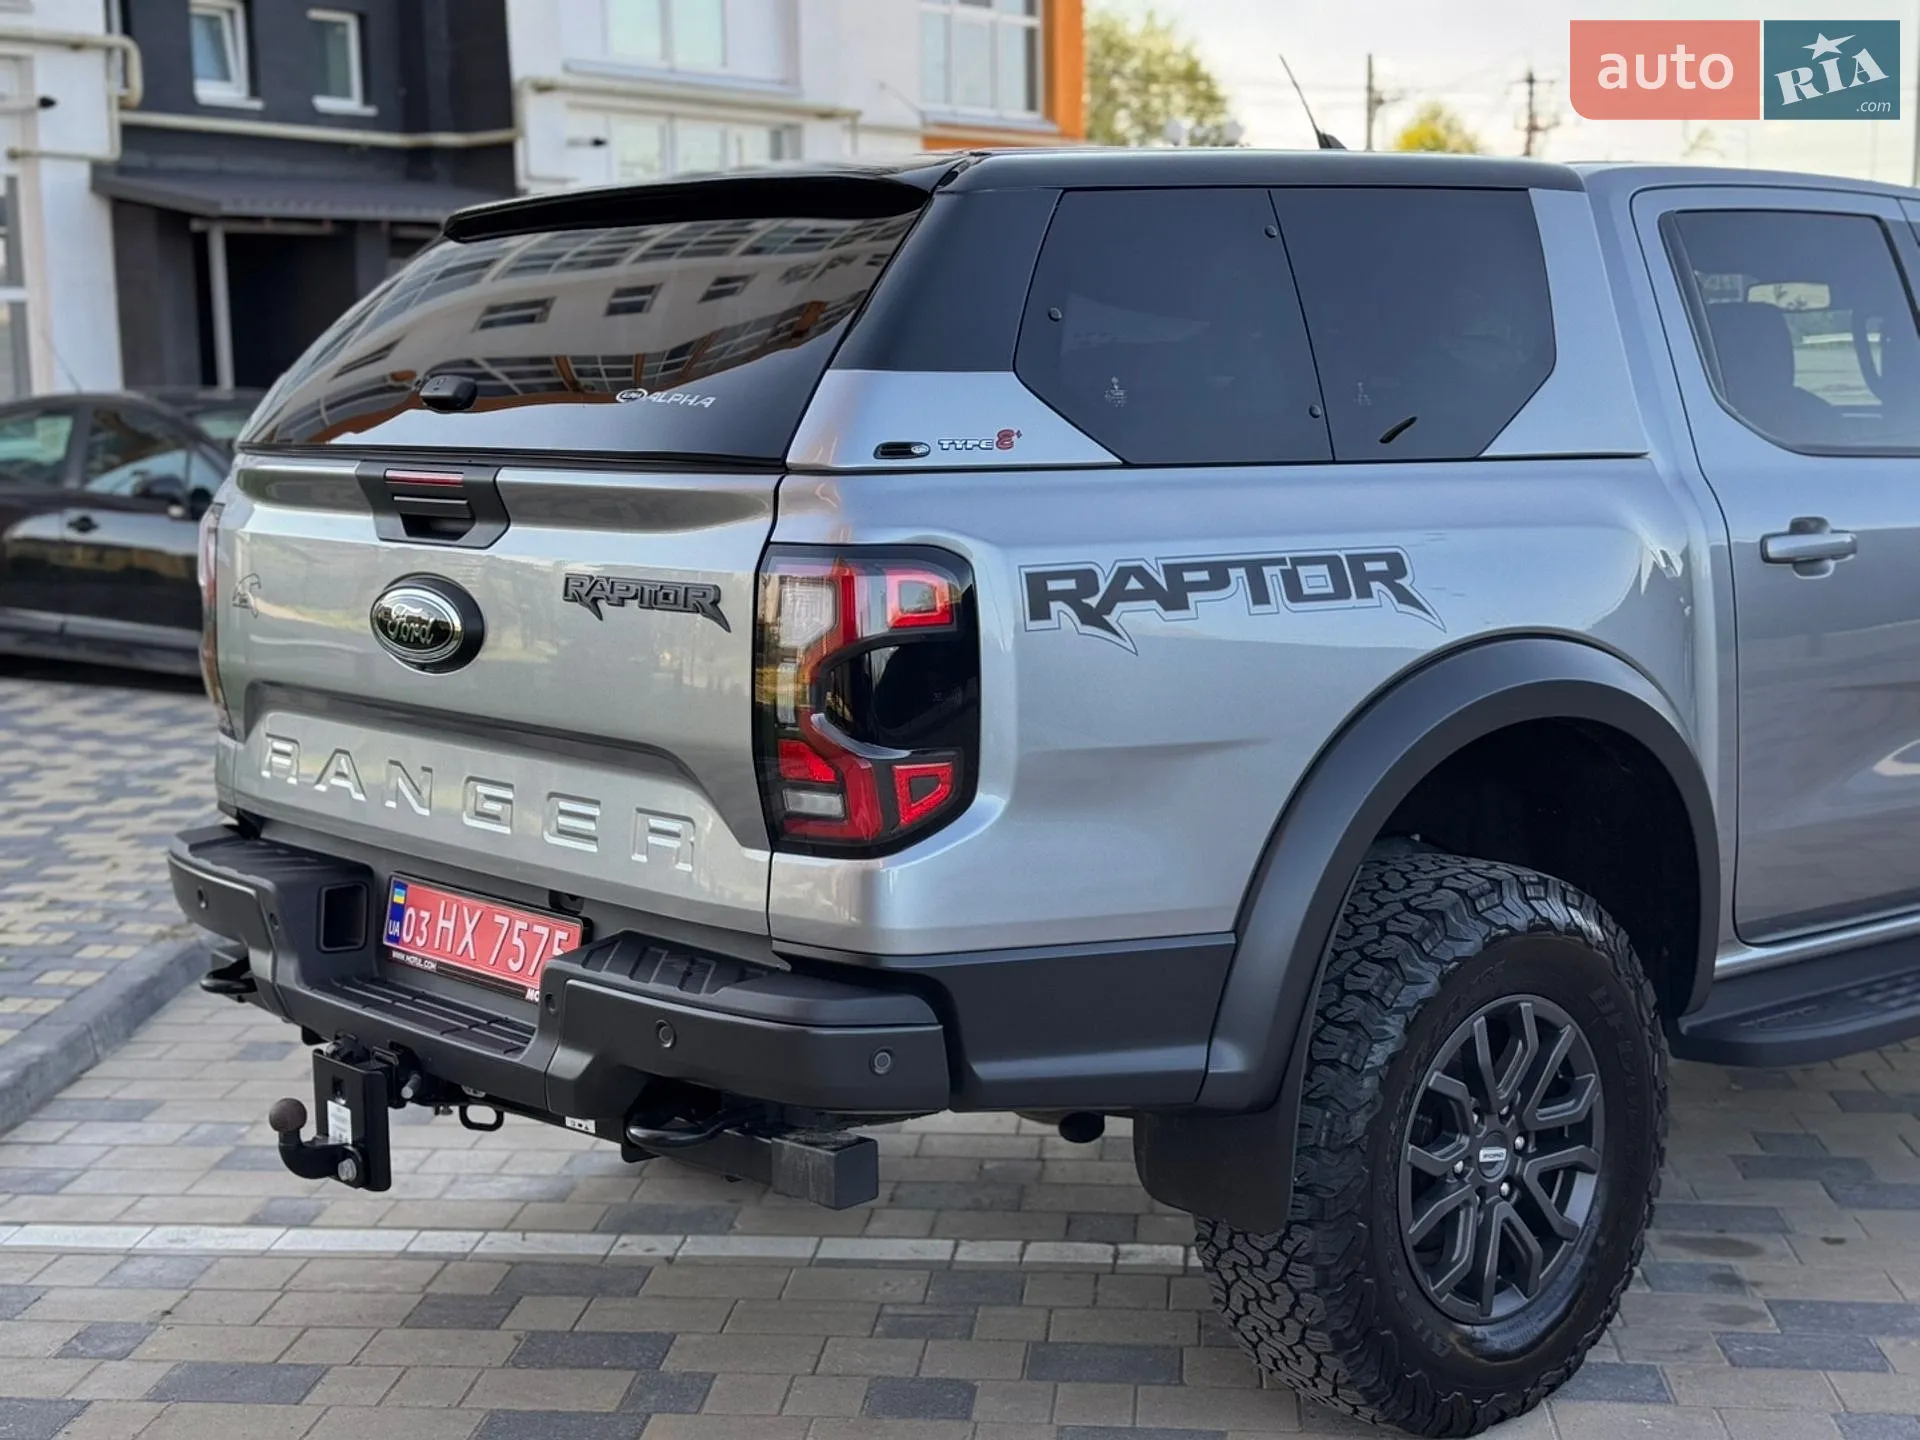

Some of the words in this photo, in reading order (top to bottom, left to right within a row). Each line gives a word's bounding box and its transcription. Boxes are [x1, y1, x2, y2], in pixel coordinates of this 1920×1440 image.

[648, 391, 717, 408] ALPHA
[938, 438, 994, 451] TYPE
[387, 602, 435, 645] Ford
[563, 572, 732, 634] RAPTOR
[1018, 545, 1447, 657] RAPTOR
[261, 732, 697, 873] RANGER
[388, 920, 400, 937] UA
[402, 907, 432, 947] 03
[434, 900, 484, 960] HX
